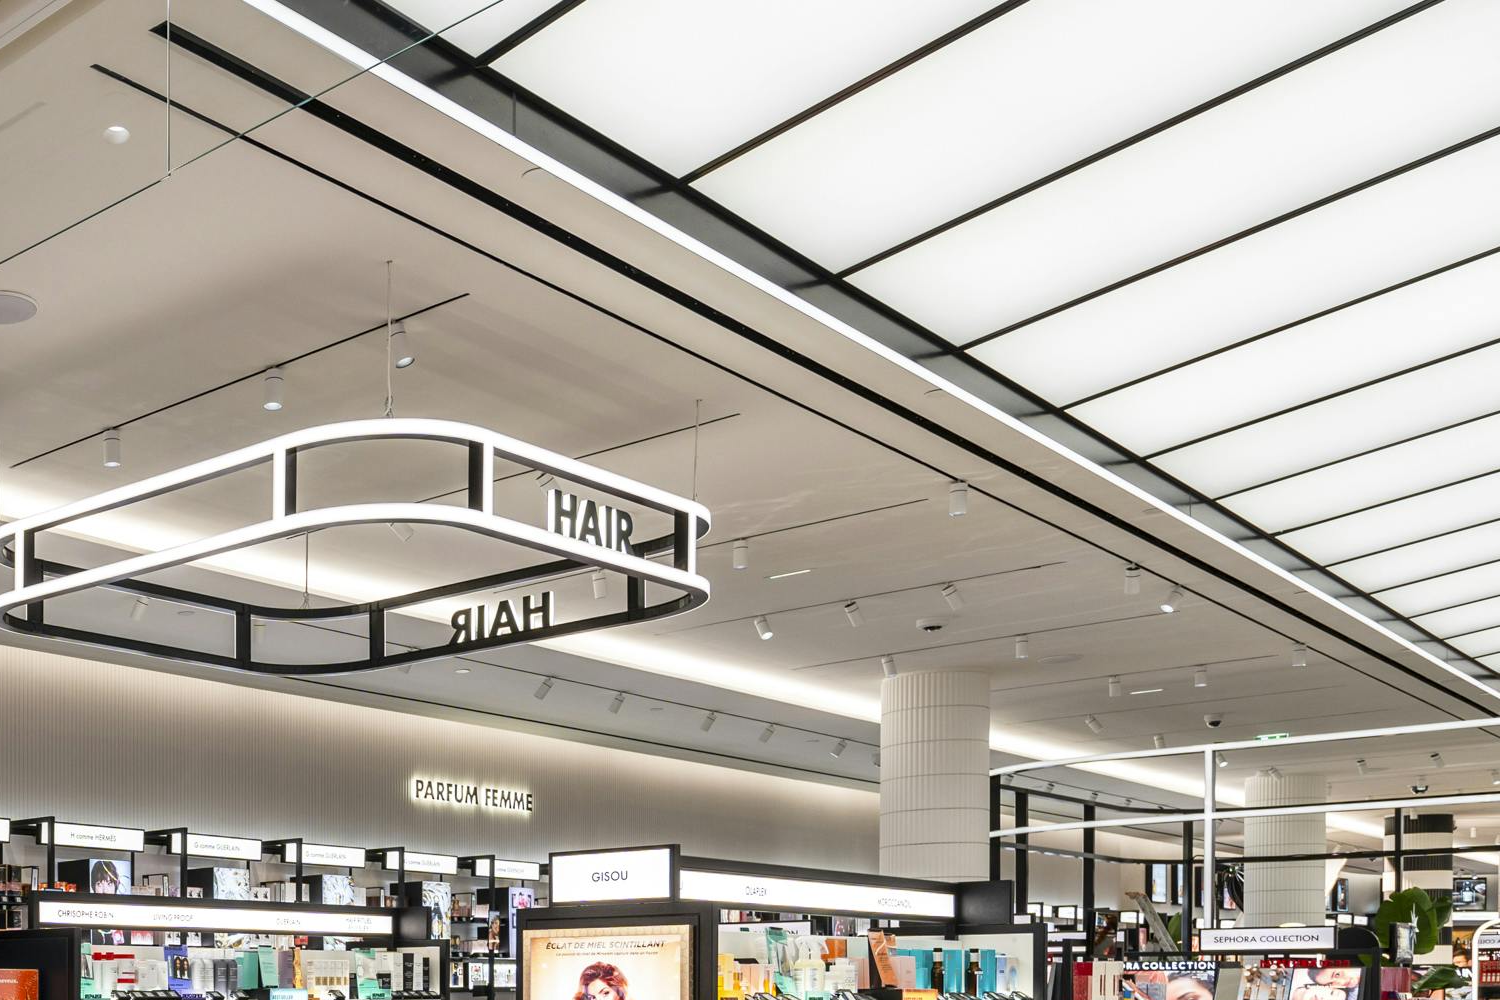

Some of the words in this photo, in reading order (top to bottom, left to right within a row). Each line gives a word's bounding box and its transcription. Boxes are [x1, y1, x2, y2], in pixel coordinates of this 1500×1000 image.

[548, 489, 635, 554] HAIR
[415, 779, 479, 805] PARFUM
[485, 788, 533, 812] FEMME
[76, 834, 94, 842] comme
[591, 870, 628, 883] GISOU
[1213, 934, 1258, 944] SEPHORA
[1259, 934, 1320, 943] COLLECTION
[545, 941, 572, 950] ÉCLAT
[1141, 961, 1217, 971] COLLECTION
